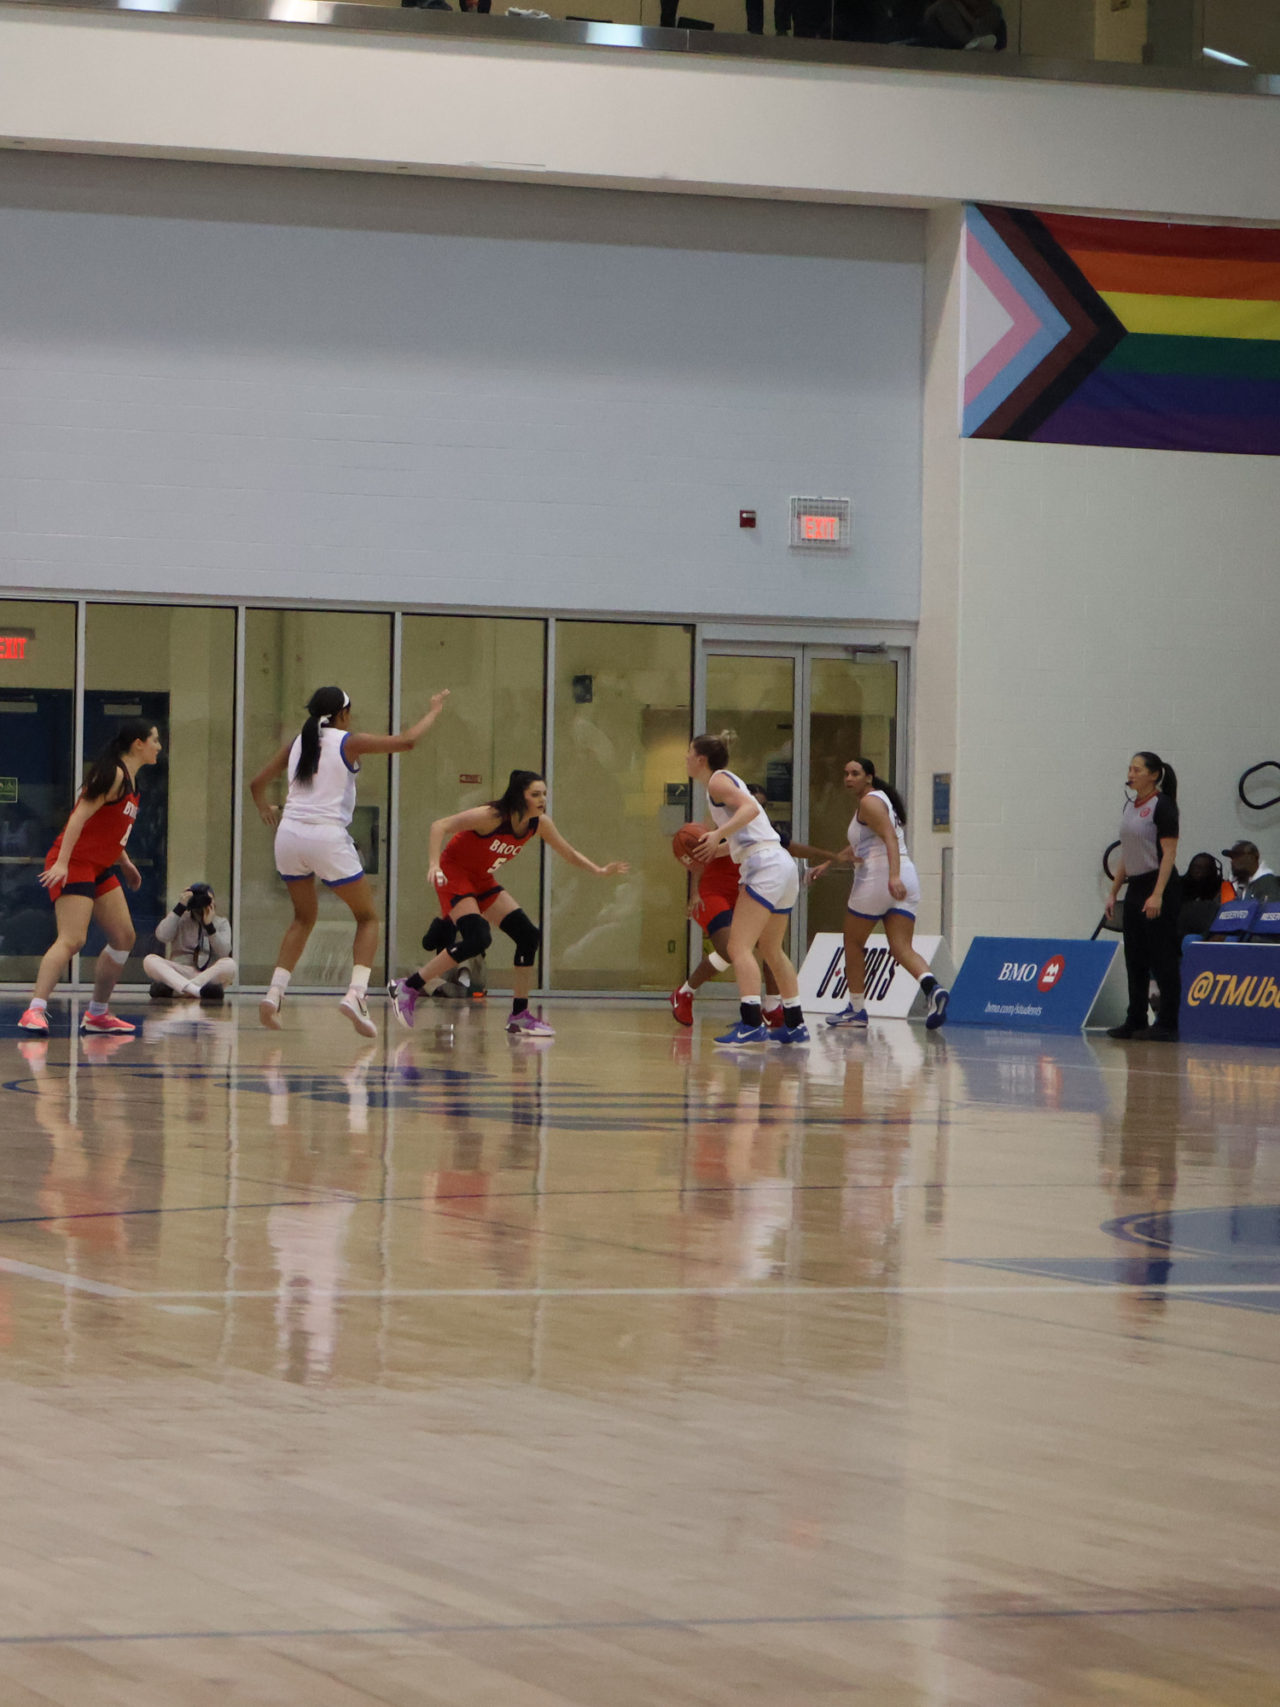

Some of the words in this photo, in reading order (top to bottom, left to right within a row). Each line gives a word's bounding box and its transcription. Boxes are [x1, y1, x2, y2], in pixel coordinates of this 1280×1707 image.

[805, 516, 836, 539] EXIT
[489, 839, 522, 856] BROC
[998, 962, 1038, 982] BMO
